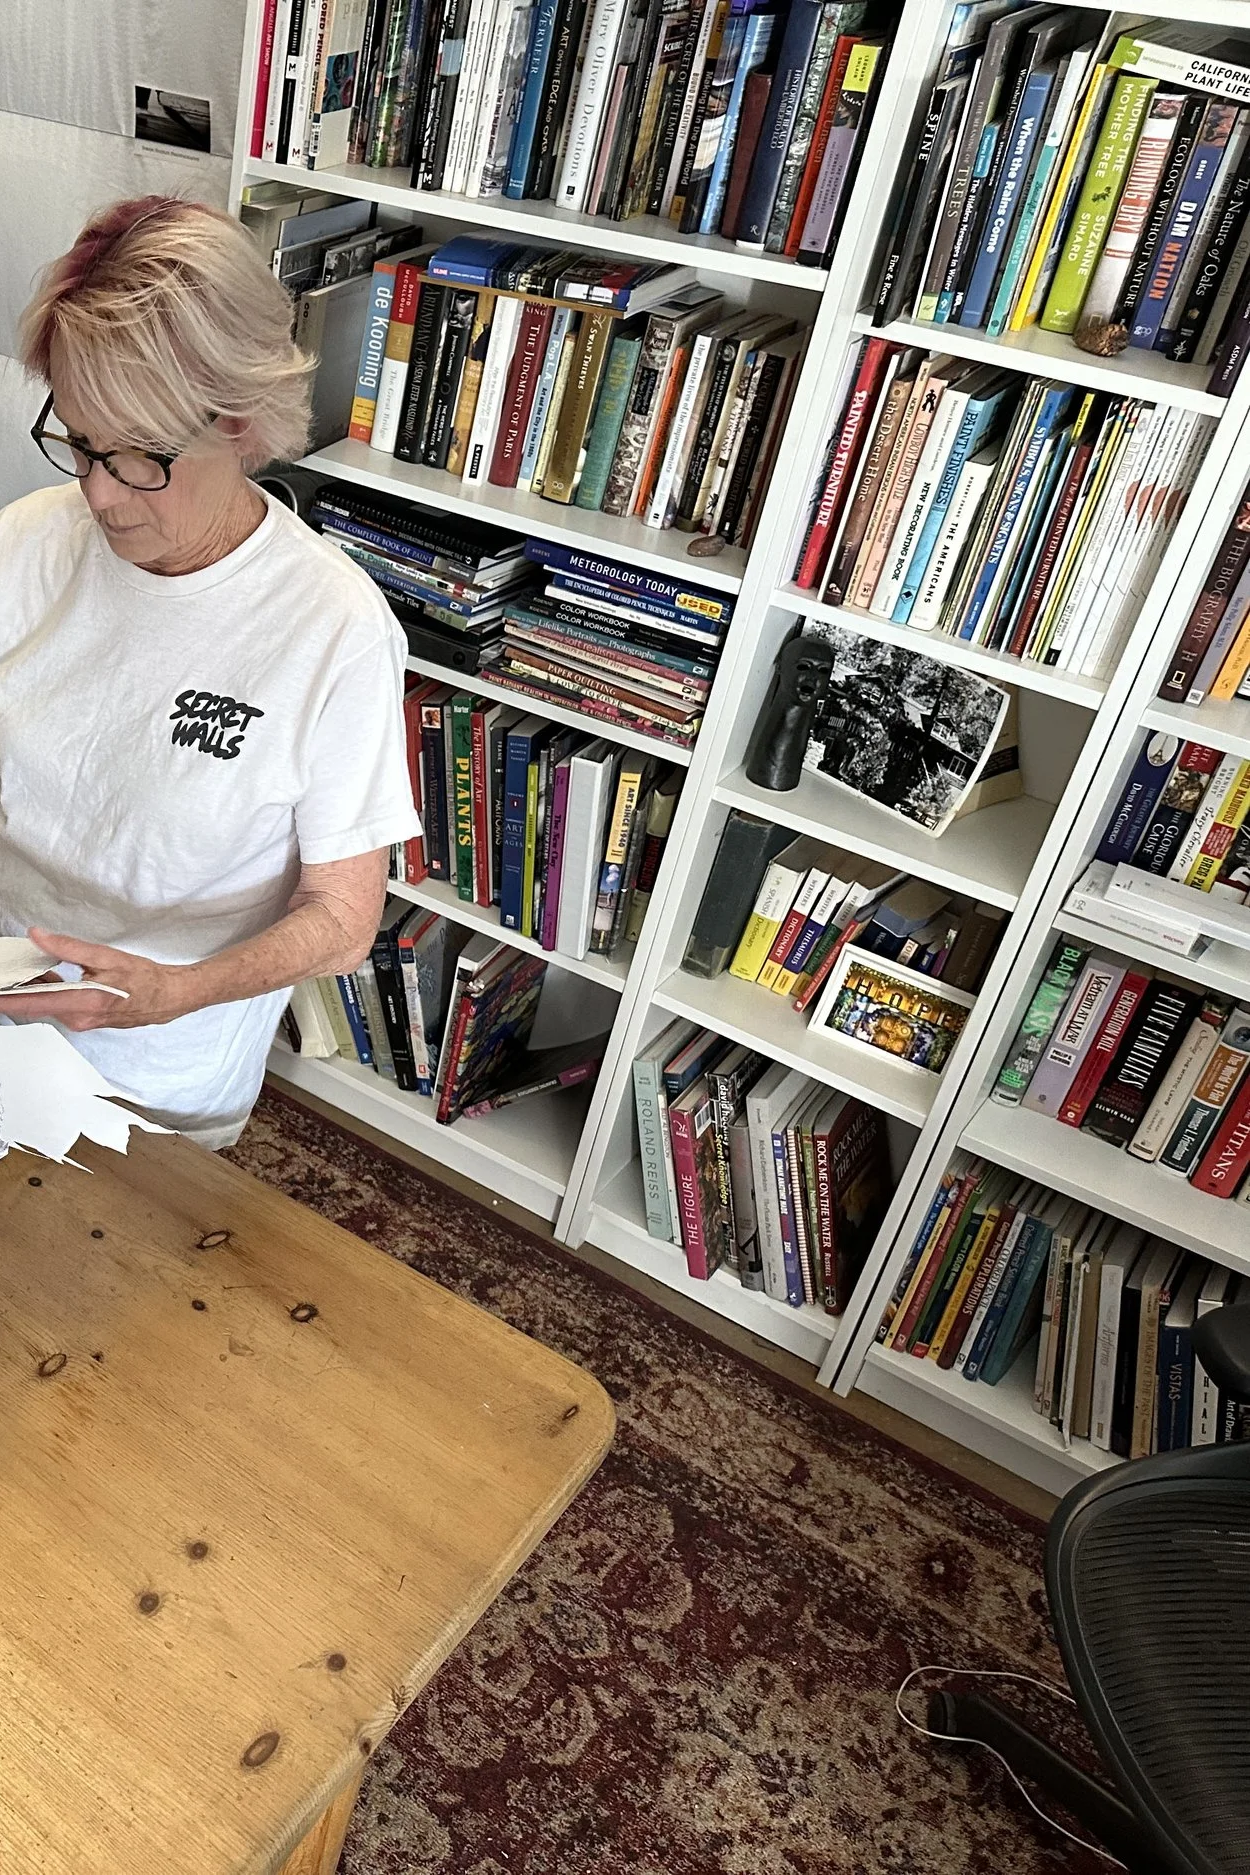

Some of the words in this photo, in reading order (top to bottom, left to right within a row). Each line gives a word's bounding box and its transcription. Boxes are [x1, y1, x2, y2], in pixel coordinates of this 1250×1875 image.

[594, 0, 615, 40] Mary
[688, 7, 700, 30] THE
[529, 4, 554, 75] VERMEER
[558, 26, 569, 48] ART
[679, 31, 696, 70] SECRET
[553, 61, 561, 76] THE
[556, 49, 563, 61] ON
[585, 45, 606, 95] Oliver
[1190, 59, 1250, 84] CALIFORN
[548, 78, 560, 104] EDGE
[676, 70, 687, 85] OF
[696, 69, 713, 105] Making
[1184, 71, 1223, 89] PLANT
[1224, 82, 1250, 97] LIFE
[544, 105, 553, 122] AND
[671, 86, 683, 108] THE
[696, 105, 705, 114] It
[1106, 82, 1133, 140] MOTHER
[1121, 82, 1149, 143] FINDING
[662, 109, 678, 148] TEMPLE
[690, 125, 700, 141] the
[694, 114, 703, 124] in
[1014, 115, 1035, 156] When
[569, 103, 595, 178] Devotions
[686, 143, 697, 157] Art
[916, 112, 939, 162] SPINE
[679, 158, 693, 185] World
[1007, 155, 1022, 180] the
[1094, 142, 1113, 178] TREE
[1111, 143, 1129, 173] THE
[1161, 135, 1191, 196] ECOLOGY
[969, 178, 979, 194] The
[996, 179, 1015, 216] Rains
[1232, 175, 1250, 197] The
[961, 193, 975, 223] Hidden
[1169, 198, 1197, 240] DAM
[1213, 198, 1241, 247] Nature
[951, 222, 967, 258] Messages
[985, 216, 1004, 254] Come
[1066, 211, 1091, 263] SIMARD
[1076, 213, 1105, 276] SUZANNE
[1139, 196, 1169, 259] WITHOUT
[886, 253, 899, 272] Fine
[949, 258, 958, 267] in
[1147, 239, 1182, 301] NATION
[1206, 247, 1222, 262] of
[884, 272, 893, 280] &
[942, 267, 955, 291] Water
[1122, 259, 1147, 309] NATURE
[1193, 261, 1218, 298] Oaks
[373, 285, 393, 314] de
[877, 281, 891, 306] Reese
[360, 315, 387, 388] Kooning
[525, 322, 541, 349] THE
[545, 338, 560, 361] Pop
[584, 327, 597, 352] SWAN
[510, 349, 534, 410] JUDGMENT
[542, 361, 555, 384] L.A.
[575, 353, 591, 390] THIEVES
[508, 411, 520, 426] OF
[532, 415, 541, 427] City
[837, 388, 868, 452] PAINTED
[883, 400, 898, 422] the
[501, 428, 518, 459] PARIS
[869, 422, 891, 464] Desert
[954, 410, 978, 450] PAINT
[1018, 425, 1046, 480] SYMBOLS,
[815, 450, 848, 528] FURNITURE
[857, 464, 878, 502] Home
[917, 481, 931, 502] NEW
[934, 448, 965, 506] FINISHES
[1005, 479, 1027, 513] SIGNS
[898, 503, 923, 557] DECORATING
[945, 521, 958, 541] THE
[1003, 511, 1014, 521] &
[333, 519, 345, 529] THE
[346, 524, 380, 542] COMPLETE
[381, 537, 401, 551] BOOK
[401, 544, 411, 554] OF
[411, 548, 433, 563] PAINT
[986, 519, 1011, 564] SIGNETS
[1224, 535, 1247, 565] THE
[568, 555, 643, 588] METEOROLOGY
[644, 578, 678, 597] TODAY
[890, 557, 905, 581] BOOK
[922, 544, 950, 605] AMERICANS
[559, 603, 586, 616] COLOR
[587, 610, 630, 629] WORKBOOK
[1189, 565, 1234, 643] BIOGRAPHY
[168, 688, 265, 733] SECRET
[171, 719, 245, 760] WALLS
[472, 743, 480, 776] HISTORY
[473, 777, 481, 785] of
[625, 787, 634, 802] ART
[1125, 781, 1142, 804] DAVID
[455, 755, 470, 847] PLANTS
[622, 804, 632, 827] SINCE
[1194, 804, 1216, 831] Tracy
[617, 828, 628, 848] 1940
[1107, 802, 1133, 845] McCULLOUGH
[1141, 821, 1165, 855] CAUSE
[1147, 823, 1179, 875] GLORIOUS
[1177, 831, 1203, 869] Chevalier
[1195, 856, 1213, 878] GREG
[773, 916, 798, 957] DICTIONARY
[790, 928, 814, 965] THESAURUS
[1048, 946, 1080, 987] BLACK
[1078, 971, 1111, 1012] Vietnam
[1075, 1008, 1089, 1021] AT
[1103, 988, 1137, 1037] GENERATION
[1144, 993, 1186, 1029] FIVE
[1062, 1018, 1085, 1044] WAR
[1095, 1034, 1116, 1053] KILL
[1115, 1026, 1170, 1089] FAMILIES
[641, 1097, 654, 1156] ROLAND
[816, 1138, 826, 1166] ROCK
[1209, 1120, 1250, 1180] TITANS
[645, 1161, 658, 1199] REISS
[817, 1166, 826, 1182] ME
[818, 1182, 826, 1197] ON
[680, 1173, 695, 1219] FIGURE
[819, 1197, 828, 1217] THE
[685, 1222, 698, 1246] THE
[820, 1216, 830, 1248] WATER
[961, 1256, 994, 1316] EXPLORATIONS
[1168, 1360, 1181, 1402] VISTAS
